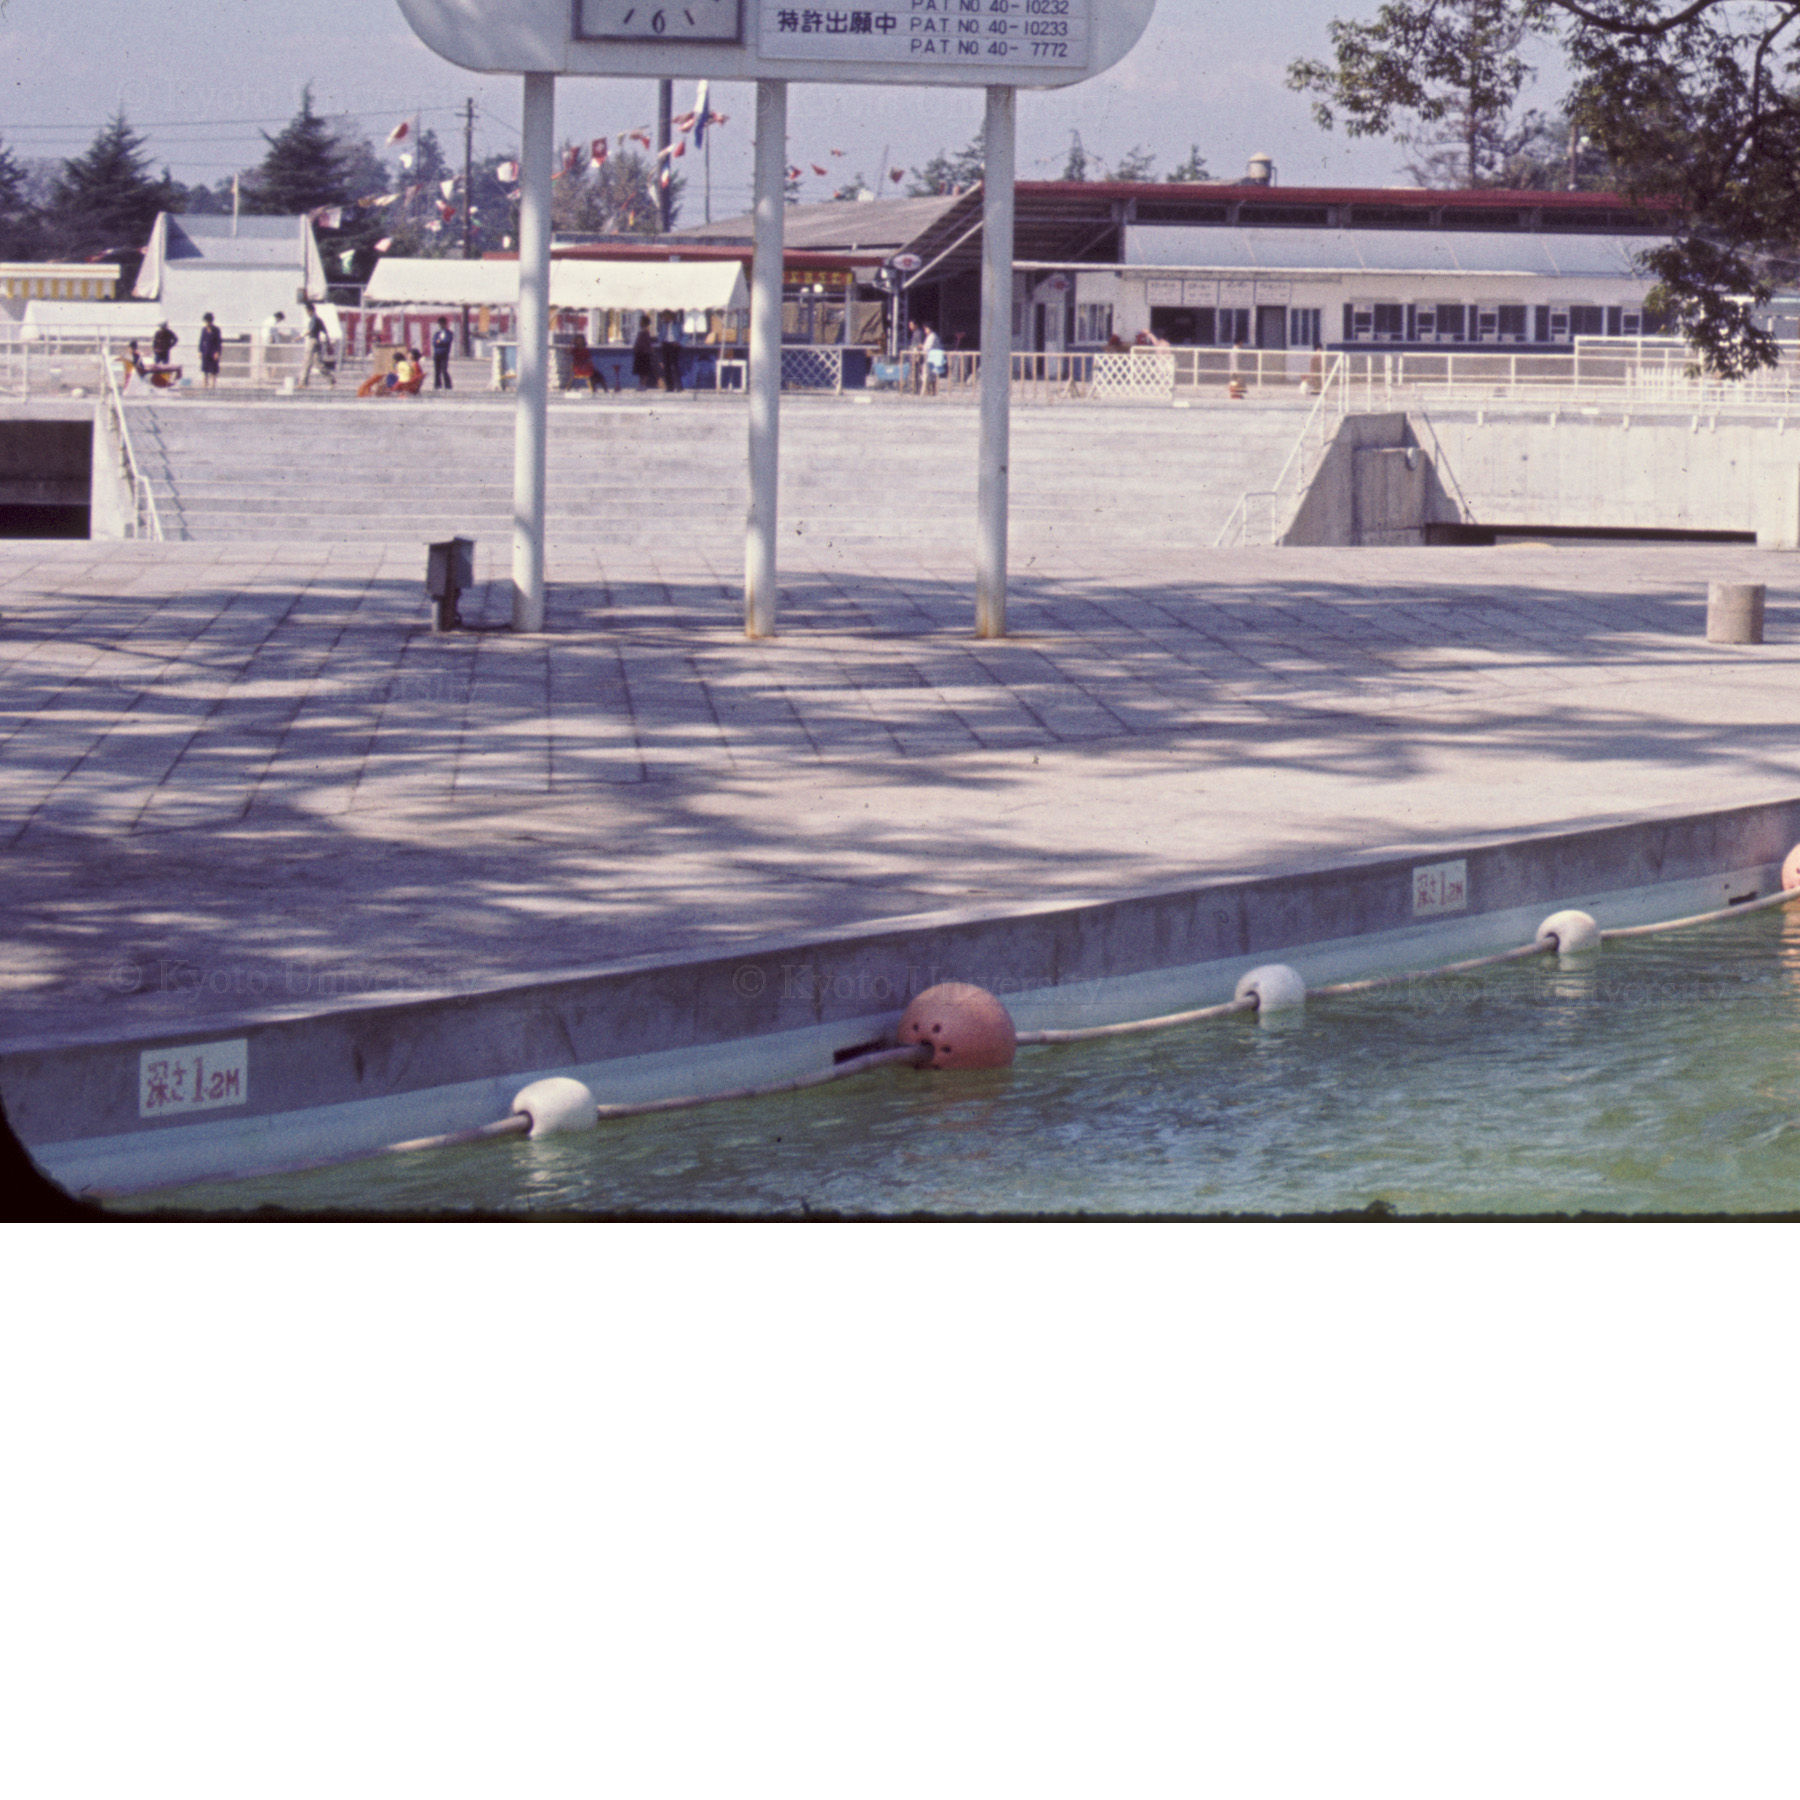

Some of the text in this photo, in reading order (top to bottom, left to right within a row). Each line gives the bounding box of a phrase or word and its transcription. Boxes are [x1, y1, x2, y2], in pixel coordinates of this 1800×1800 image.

[652, 9, 666, 35] 6
[777, 9, 897, 35] 特許出願中
